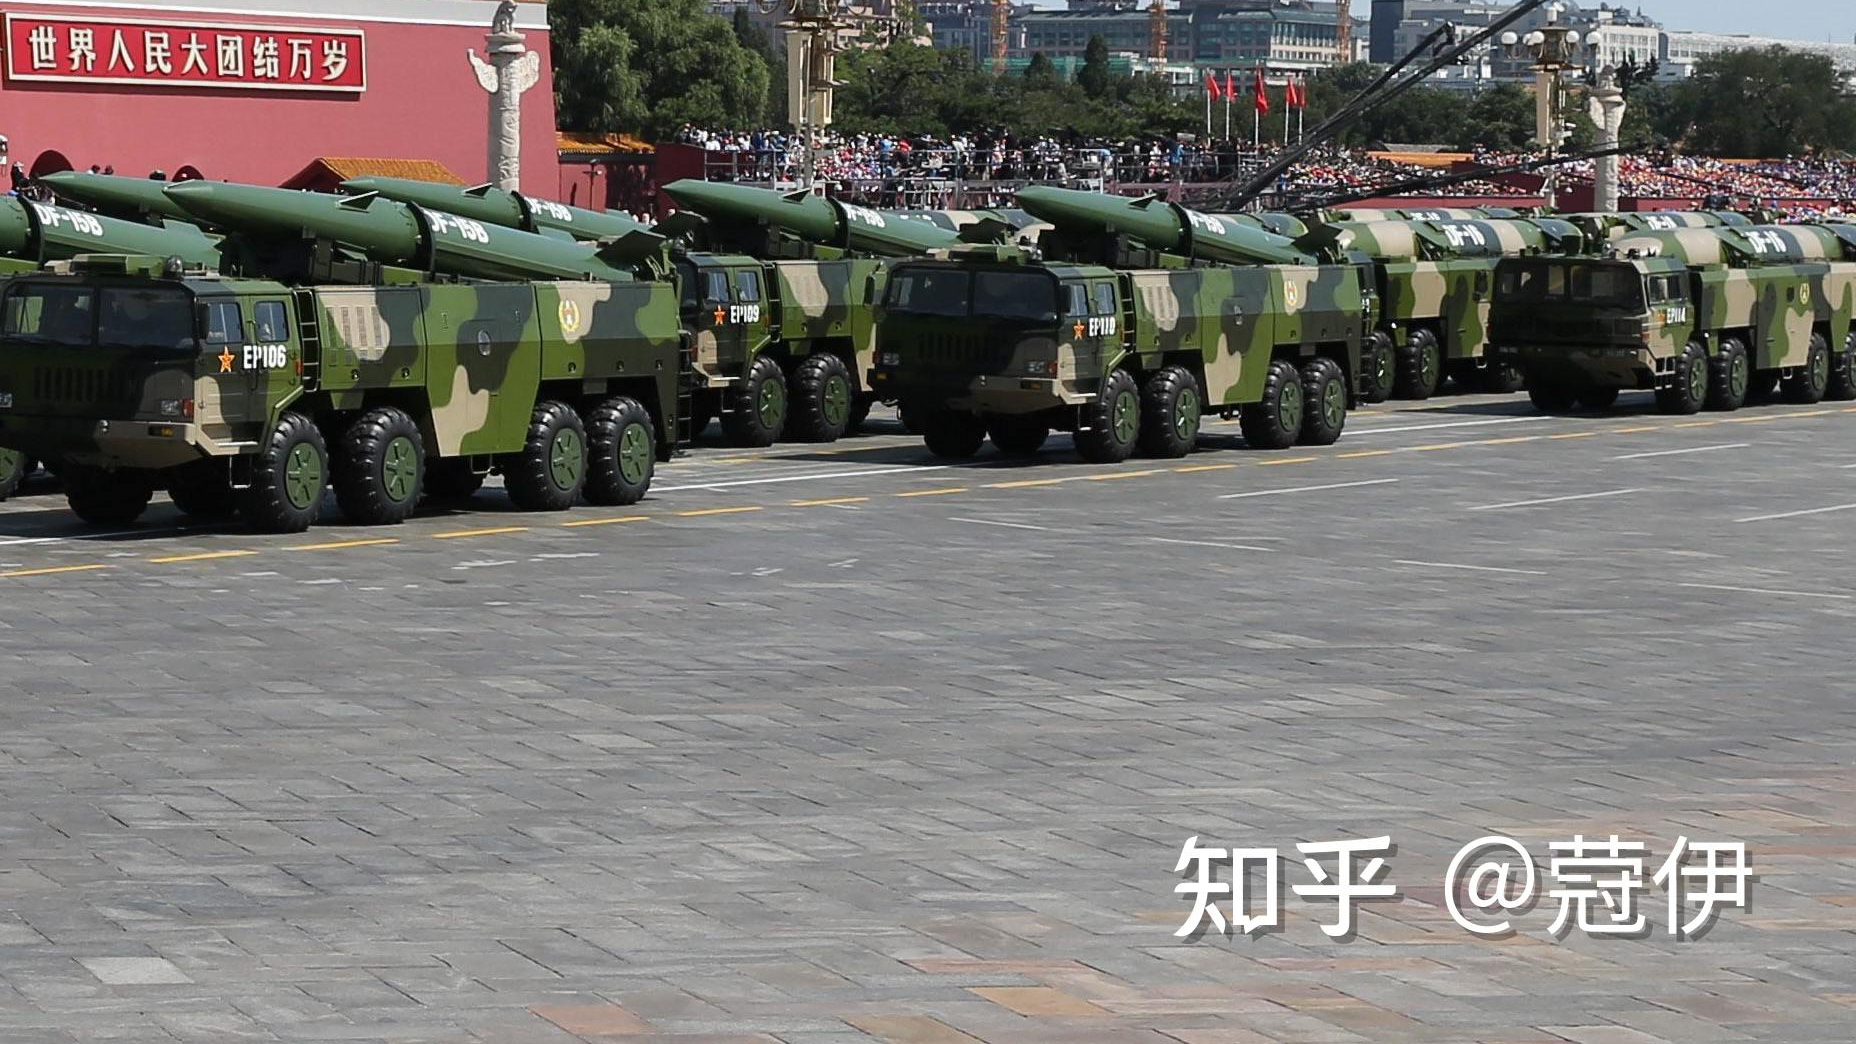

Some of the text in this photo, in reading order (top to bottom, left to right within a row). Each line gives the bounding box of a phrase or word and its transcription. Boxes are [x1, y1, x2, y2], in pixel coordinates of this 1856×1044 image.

[29, 26, 349, 81] 世界人民大团结万岁
[33, 204, 103, 236] DF-15B
[730, 304, 760, 324] EP109
[1089, 316, 1116, 336] EP110
[243, 344, 287, 369] EP106
